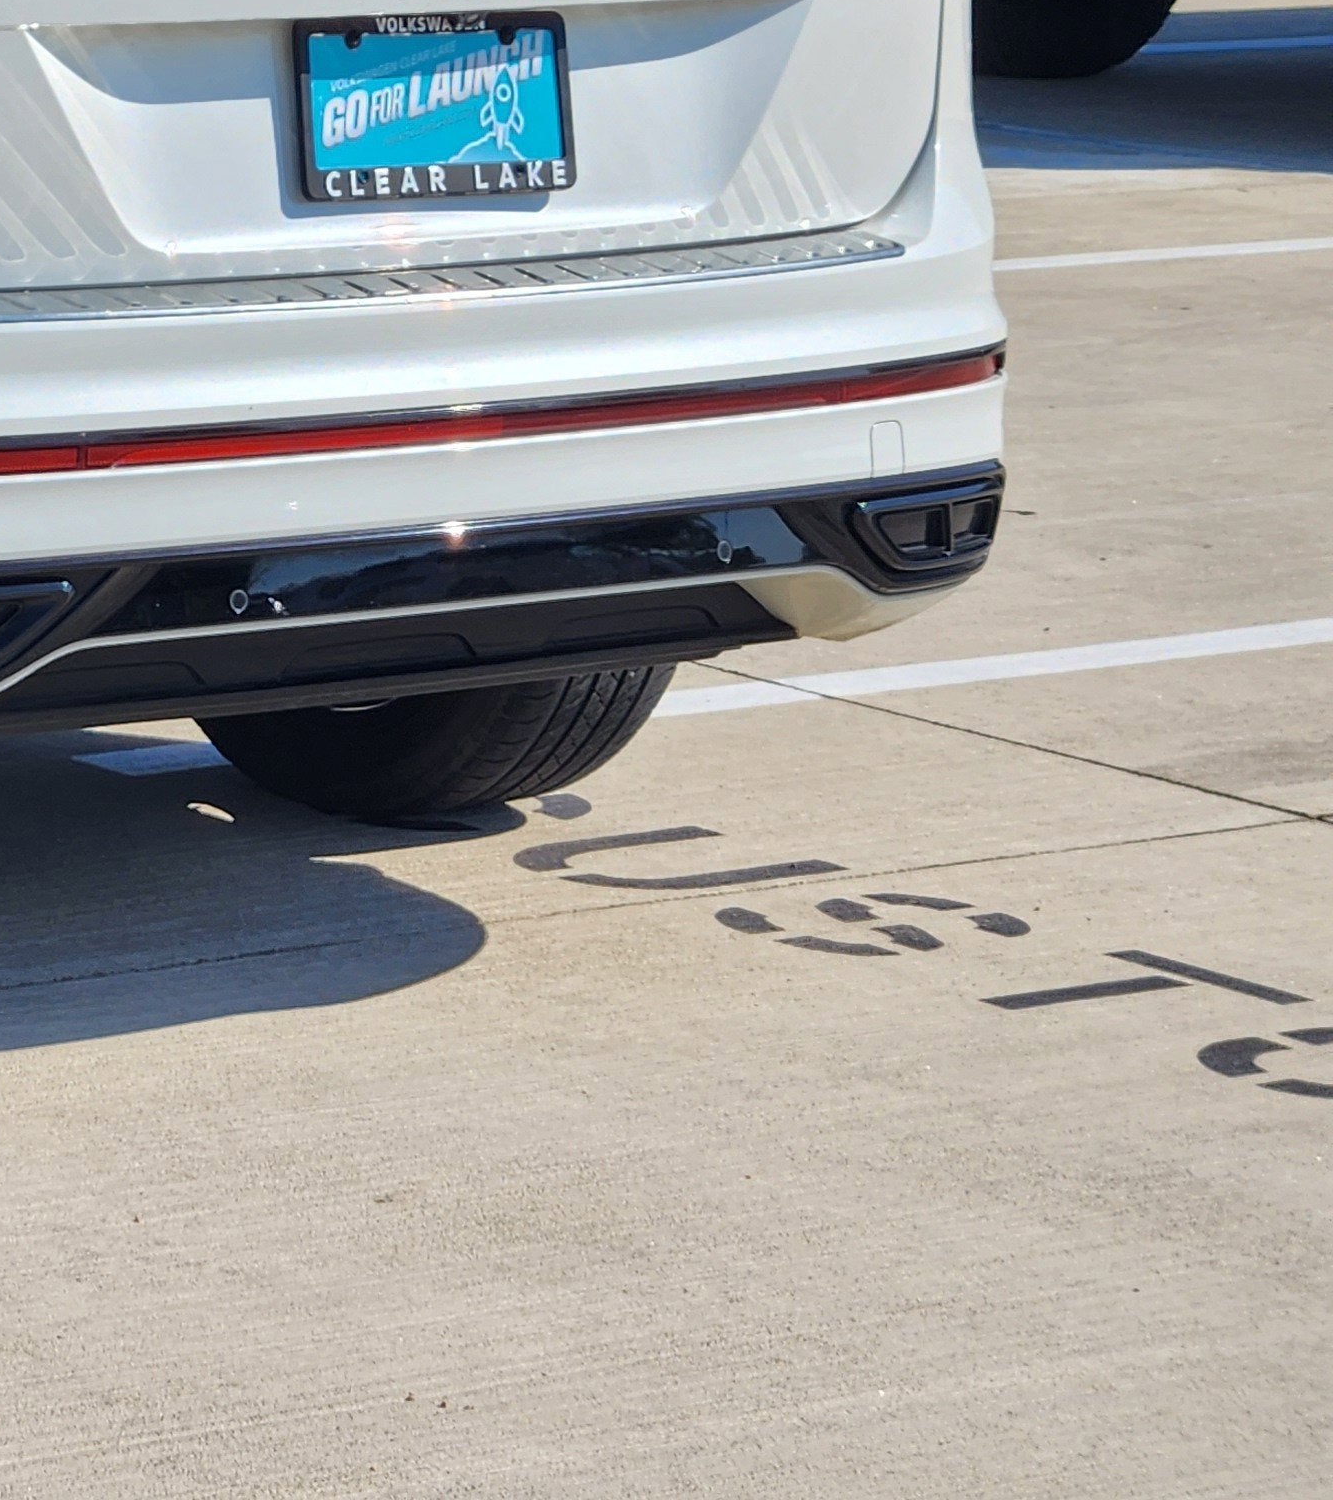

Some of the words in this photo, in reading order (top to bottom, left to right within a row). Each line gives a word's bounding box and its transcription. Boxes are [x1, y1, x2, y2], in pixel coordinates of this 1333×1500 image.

[321, 88, 369, 148] GO
[369, 82, 406, 128] FOR
[407, 30, 545, 119] LAUNCH
[324, 164, 448, 199] CLEAR
[474, 160, 568, 191] LAKE
